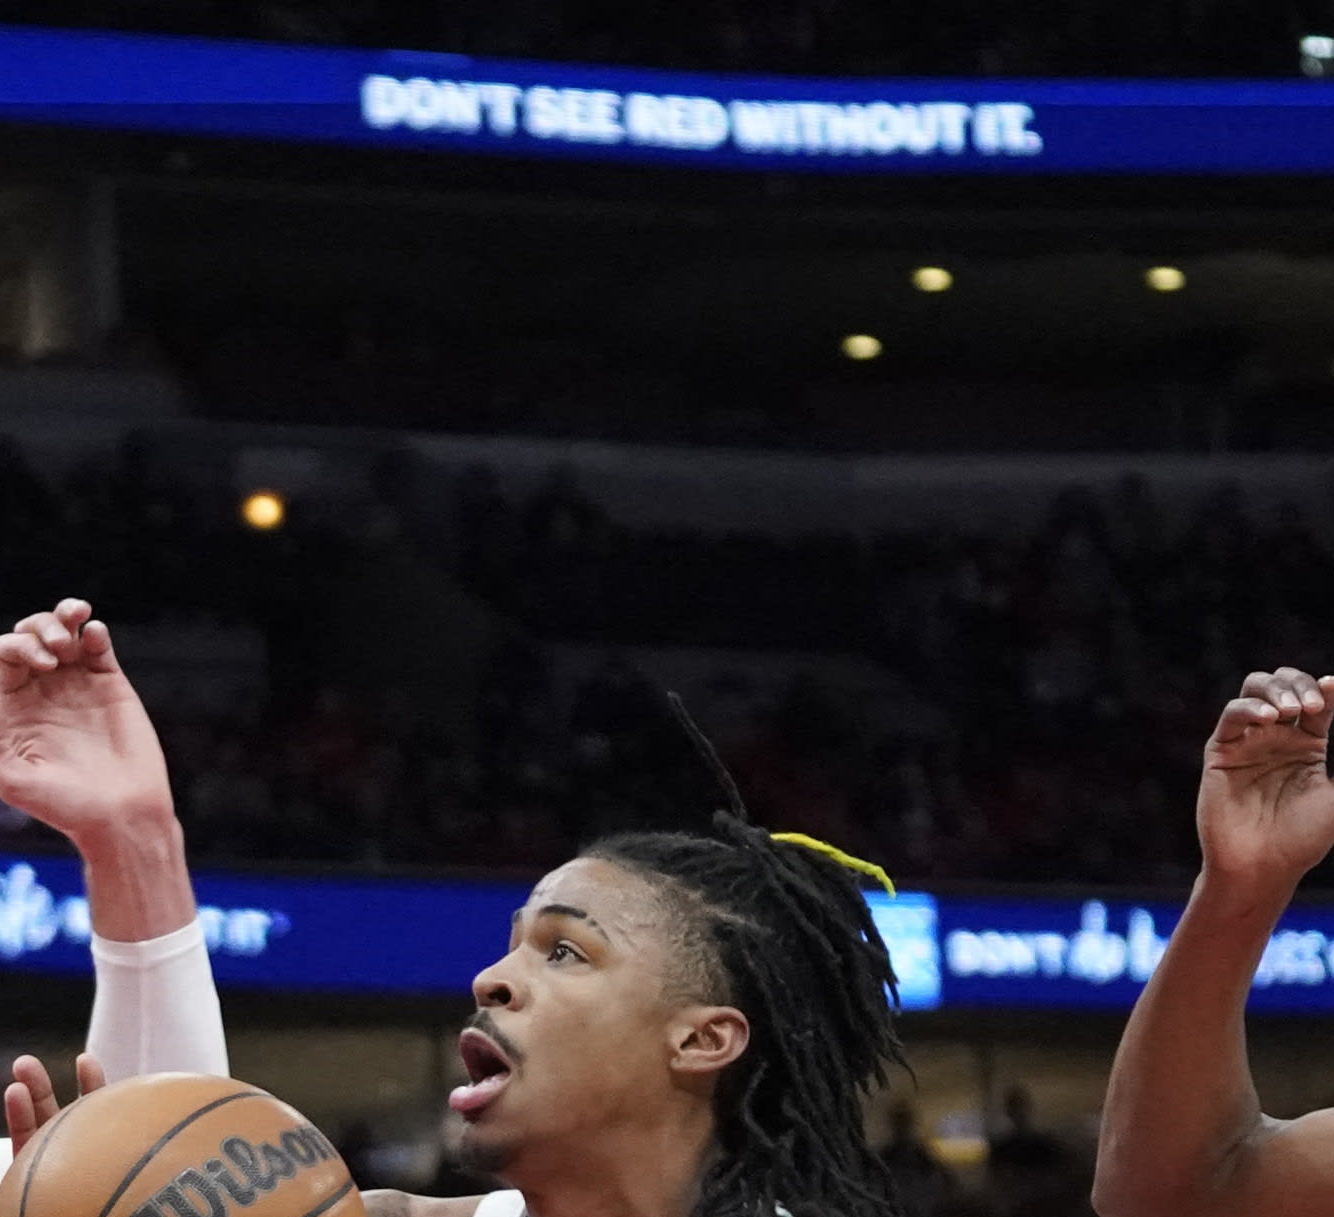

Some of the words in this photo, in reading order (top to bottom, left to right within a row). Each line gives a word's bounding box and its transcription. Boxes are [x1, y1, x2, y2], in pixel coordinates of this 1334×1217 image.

[523, 85, 625, 144] SEE
[626, 92, 729, 151] RED
[729, 99, 970, 155] WITHOUT
[971, 101, 1043, 156] IT.
[1068, 899, 1127, 985] do
